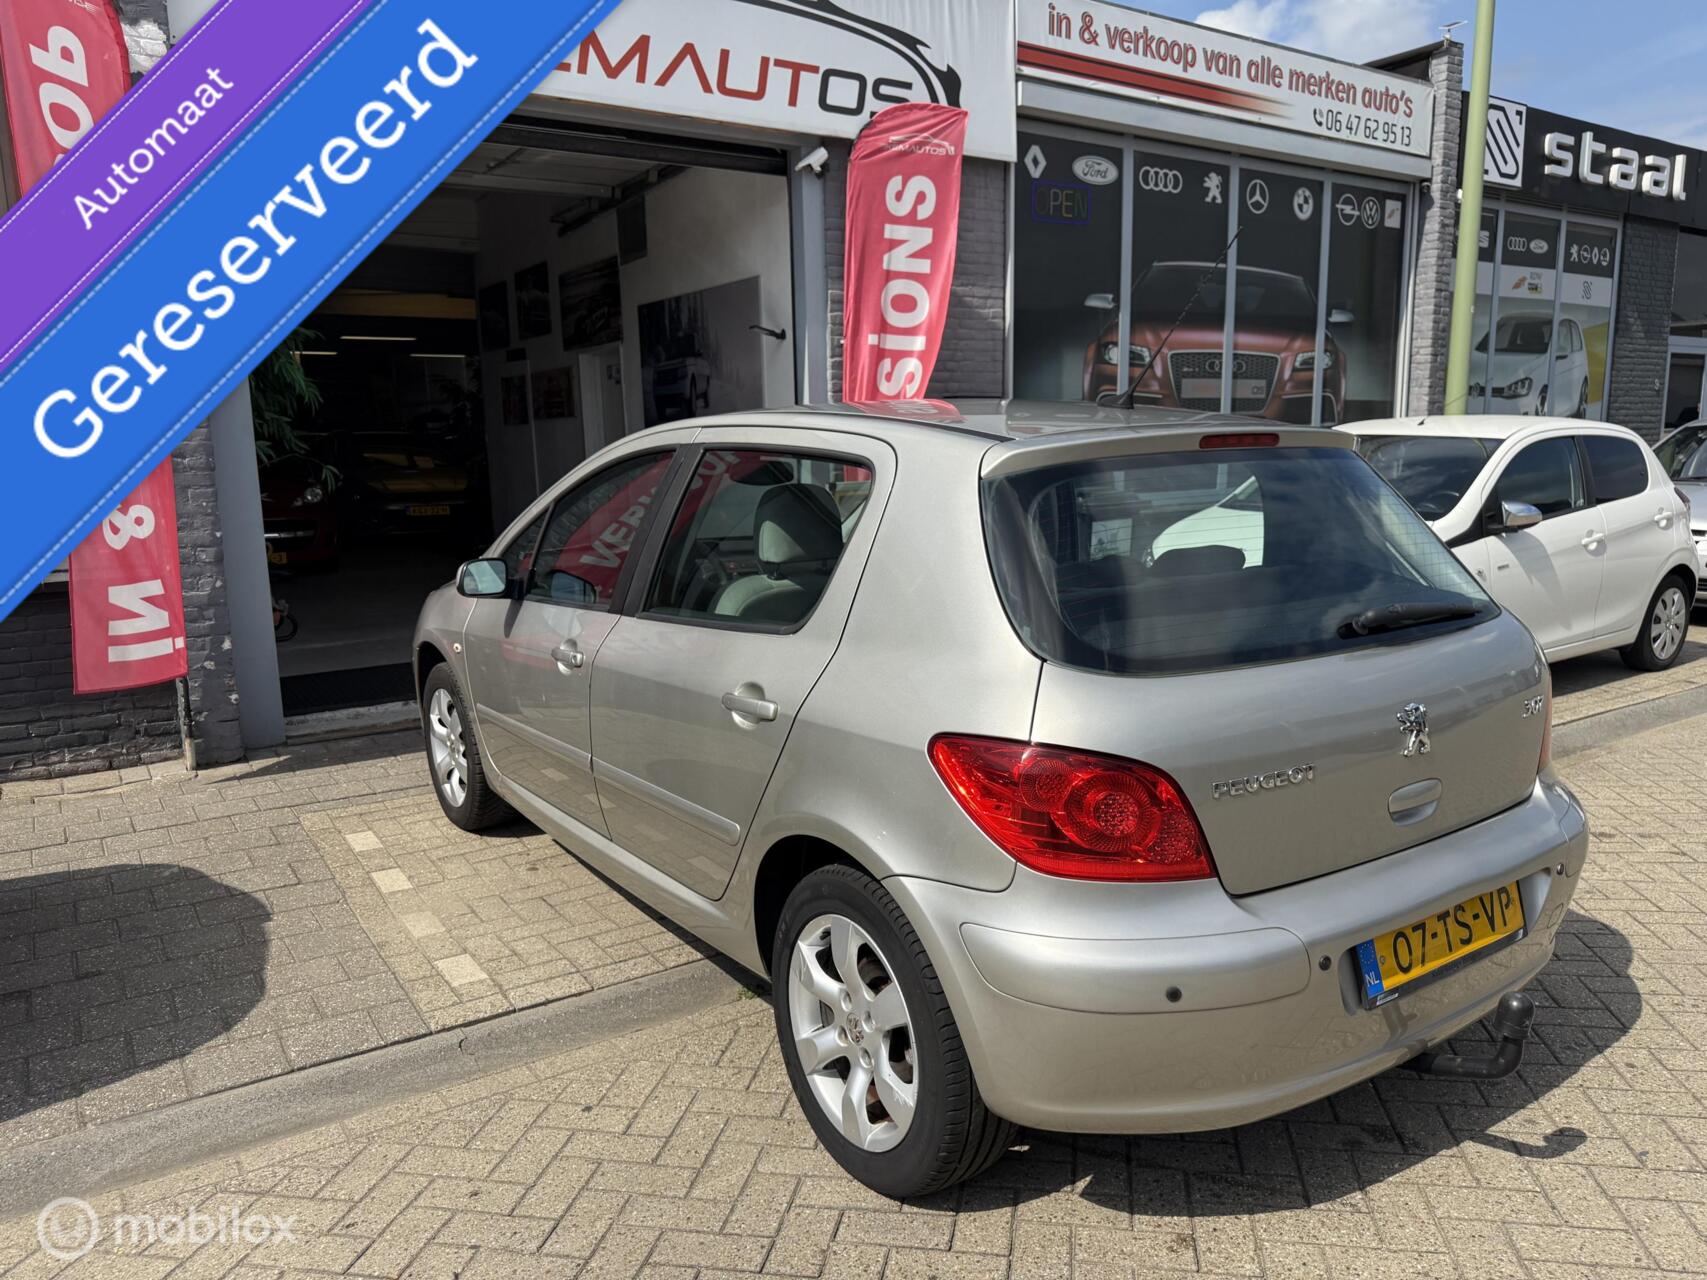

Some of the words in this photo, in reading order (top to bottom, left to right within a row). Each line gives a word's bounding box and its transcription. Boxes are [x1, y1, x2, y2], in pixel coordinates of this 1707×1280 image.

[552, 29, 914, 119] MAUTOS
[1048, 2, 1072, 39] in
[1079, 11, 1099, 46] &
[1104, 24, 1197, 72] verkoop
[1202, 47, 1242, 79] van
[1246, 55, 1284, 88] alle
[1287, 70, 1357, 106] merken
[1361, 86, 1414, 118] auto's
[1325, 109, 1342, 133] 06
[1345, 114, 1362, 137] 47
[1364, 118, 1380, 141] 62
[1382, 122, 1398, 144] 95
[1400, 126, 1412, 147] 13
[1544, 131, 1687, 201] staal
[1036, 187, 1088, 219] OPEN
[1213, 764, 1315, 799] PEUGEOT
[1392, 885, 1515, 974] 07-TS-VP
[1364, 970, 1380, 988] NL
